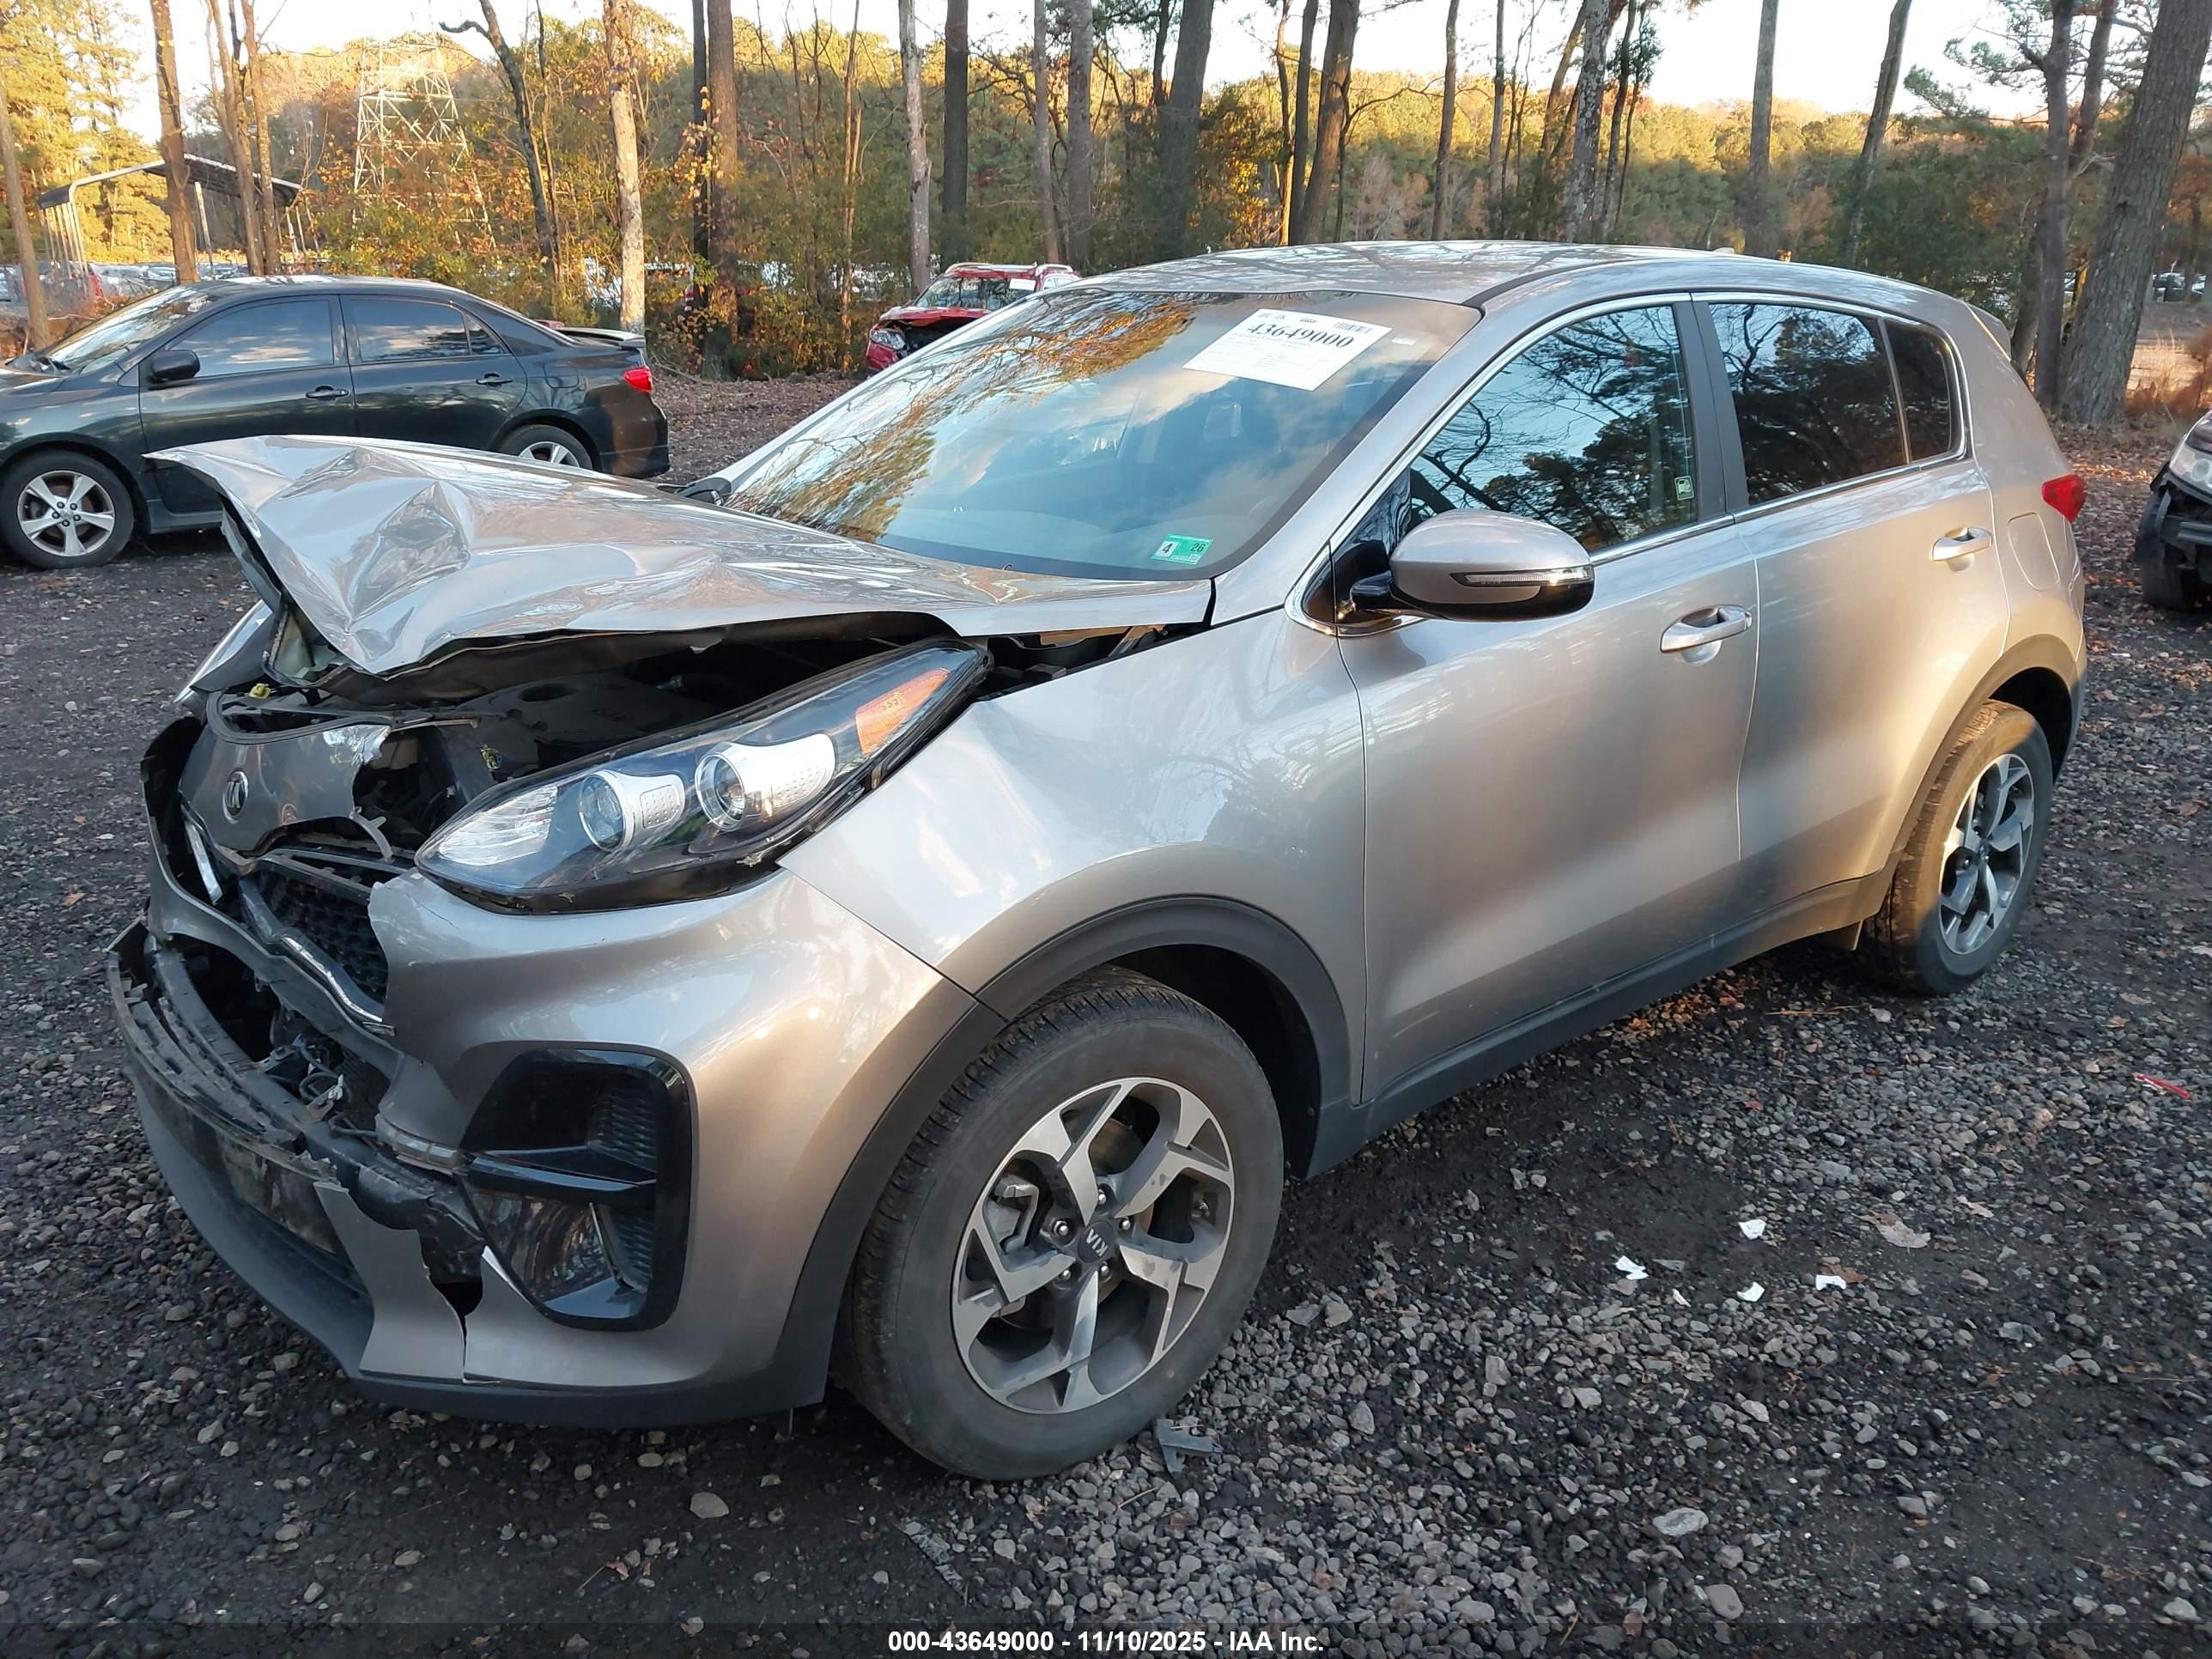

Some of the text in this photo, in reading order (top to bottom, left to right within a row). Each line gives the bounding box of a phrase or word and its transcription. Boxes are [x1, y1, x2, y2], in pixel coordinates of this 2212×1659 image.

[1247, 322, 1355, 349] 43649000
[1162, 543, 1174, 554] 4
[1190, 543, 1206, 552] 26
[1085, 1228, 1109, 1257] KIA
